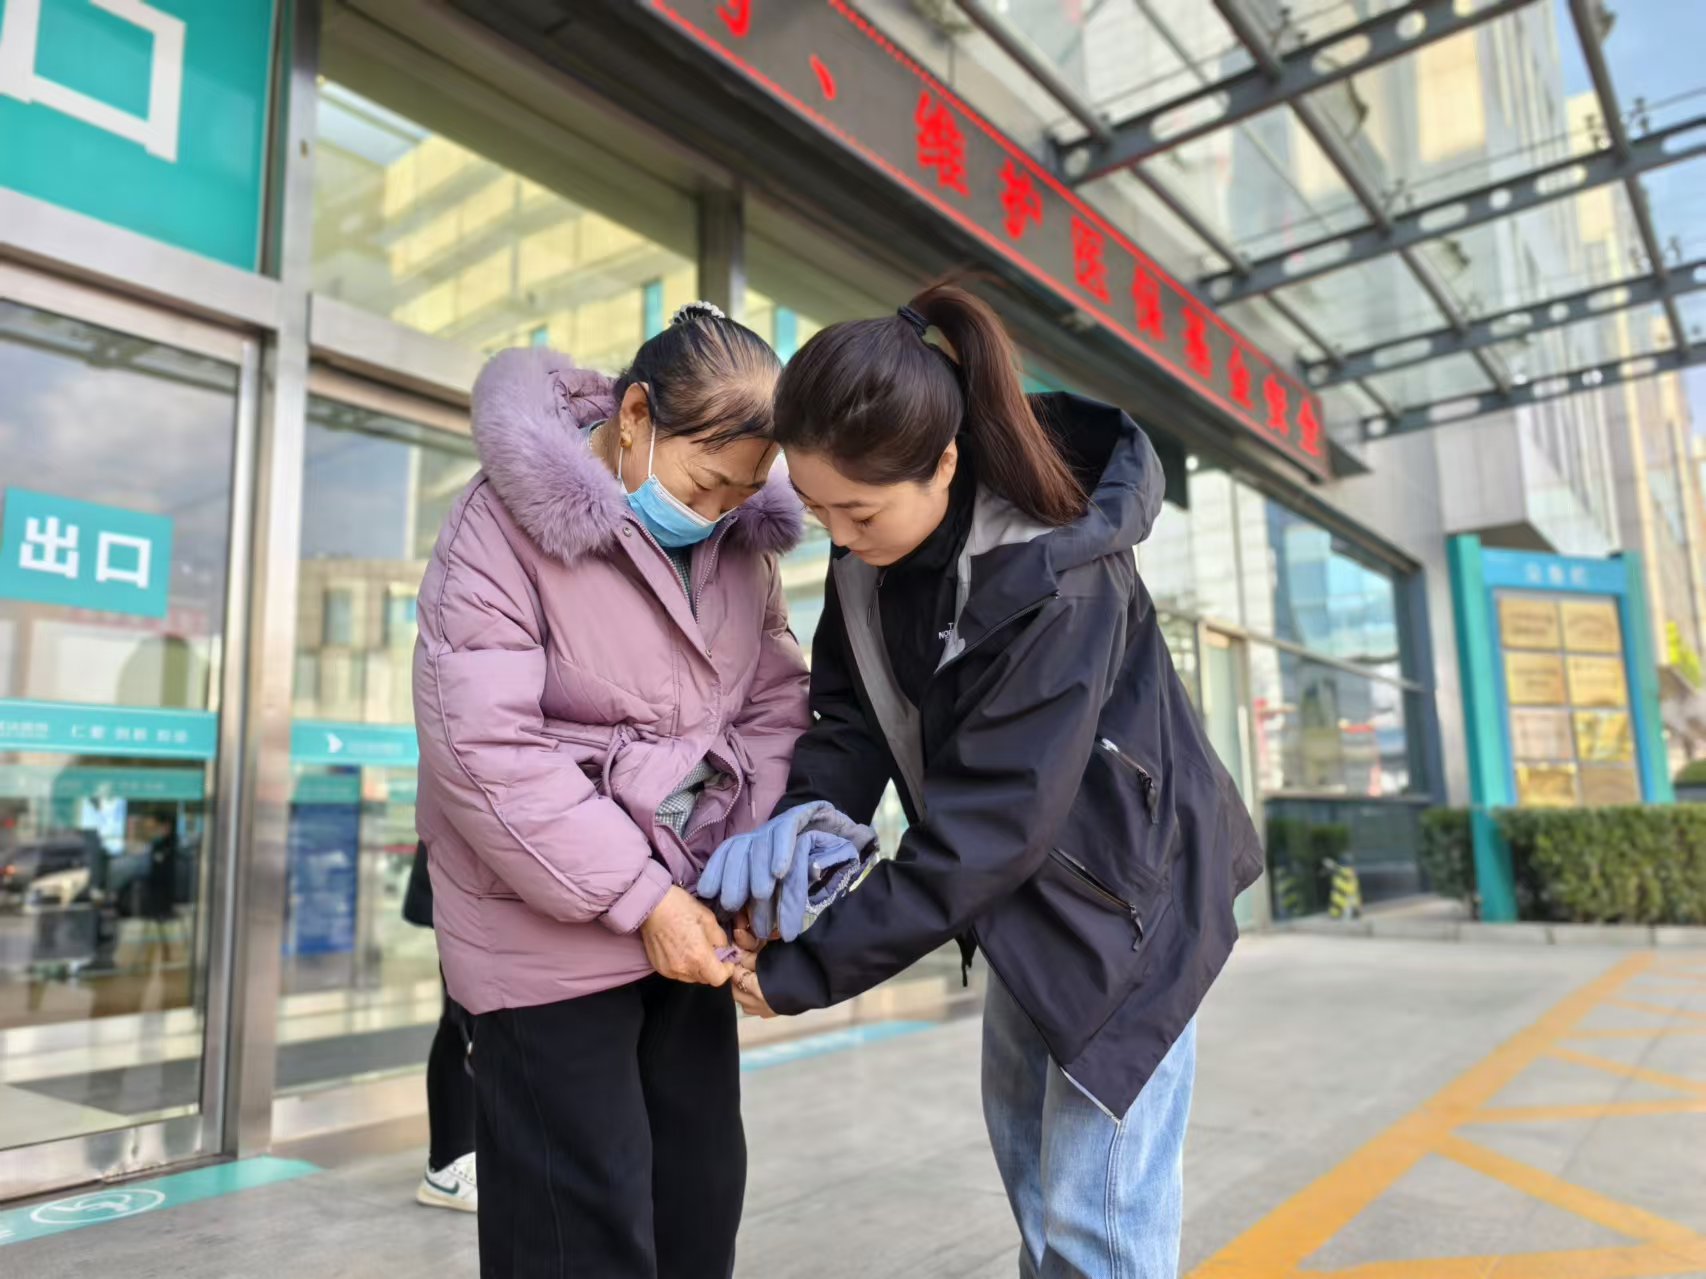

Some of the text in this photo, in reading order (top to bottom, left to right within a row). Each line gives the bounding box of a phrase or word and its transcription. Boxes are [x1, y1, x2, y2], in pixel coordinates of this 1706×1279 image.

[717, 0, 1321, 458] 、维护医保基金安全
[18, 515, 152, 590] 出口
